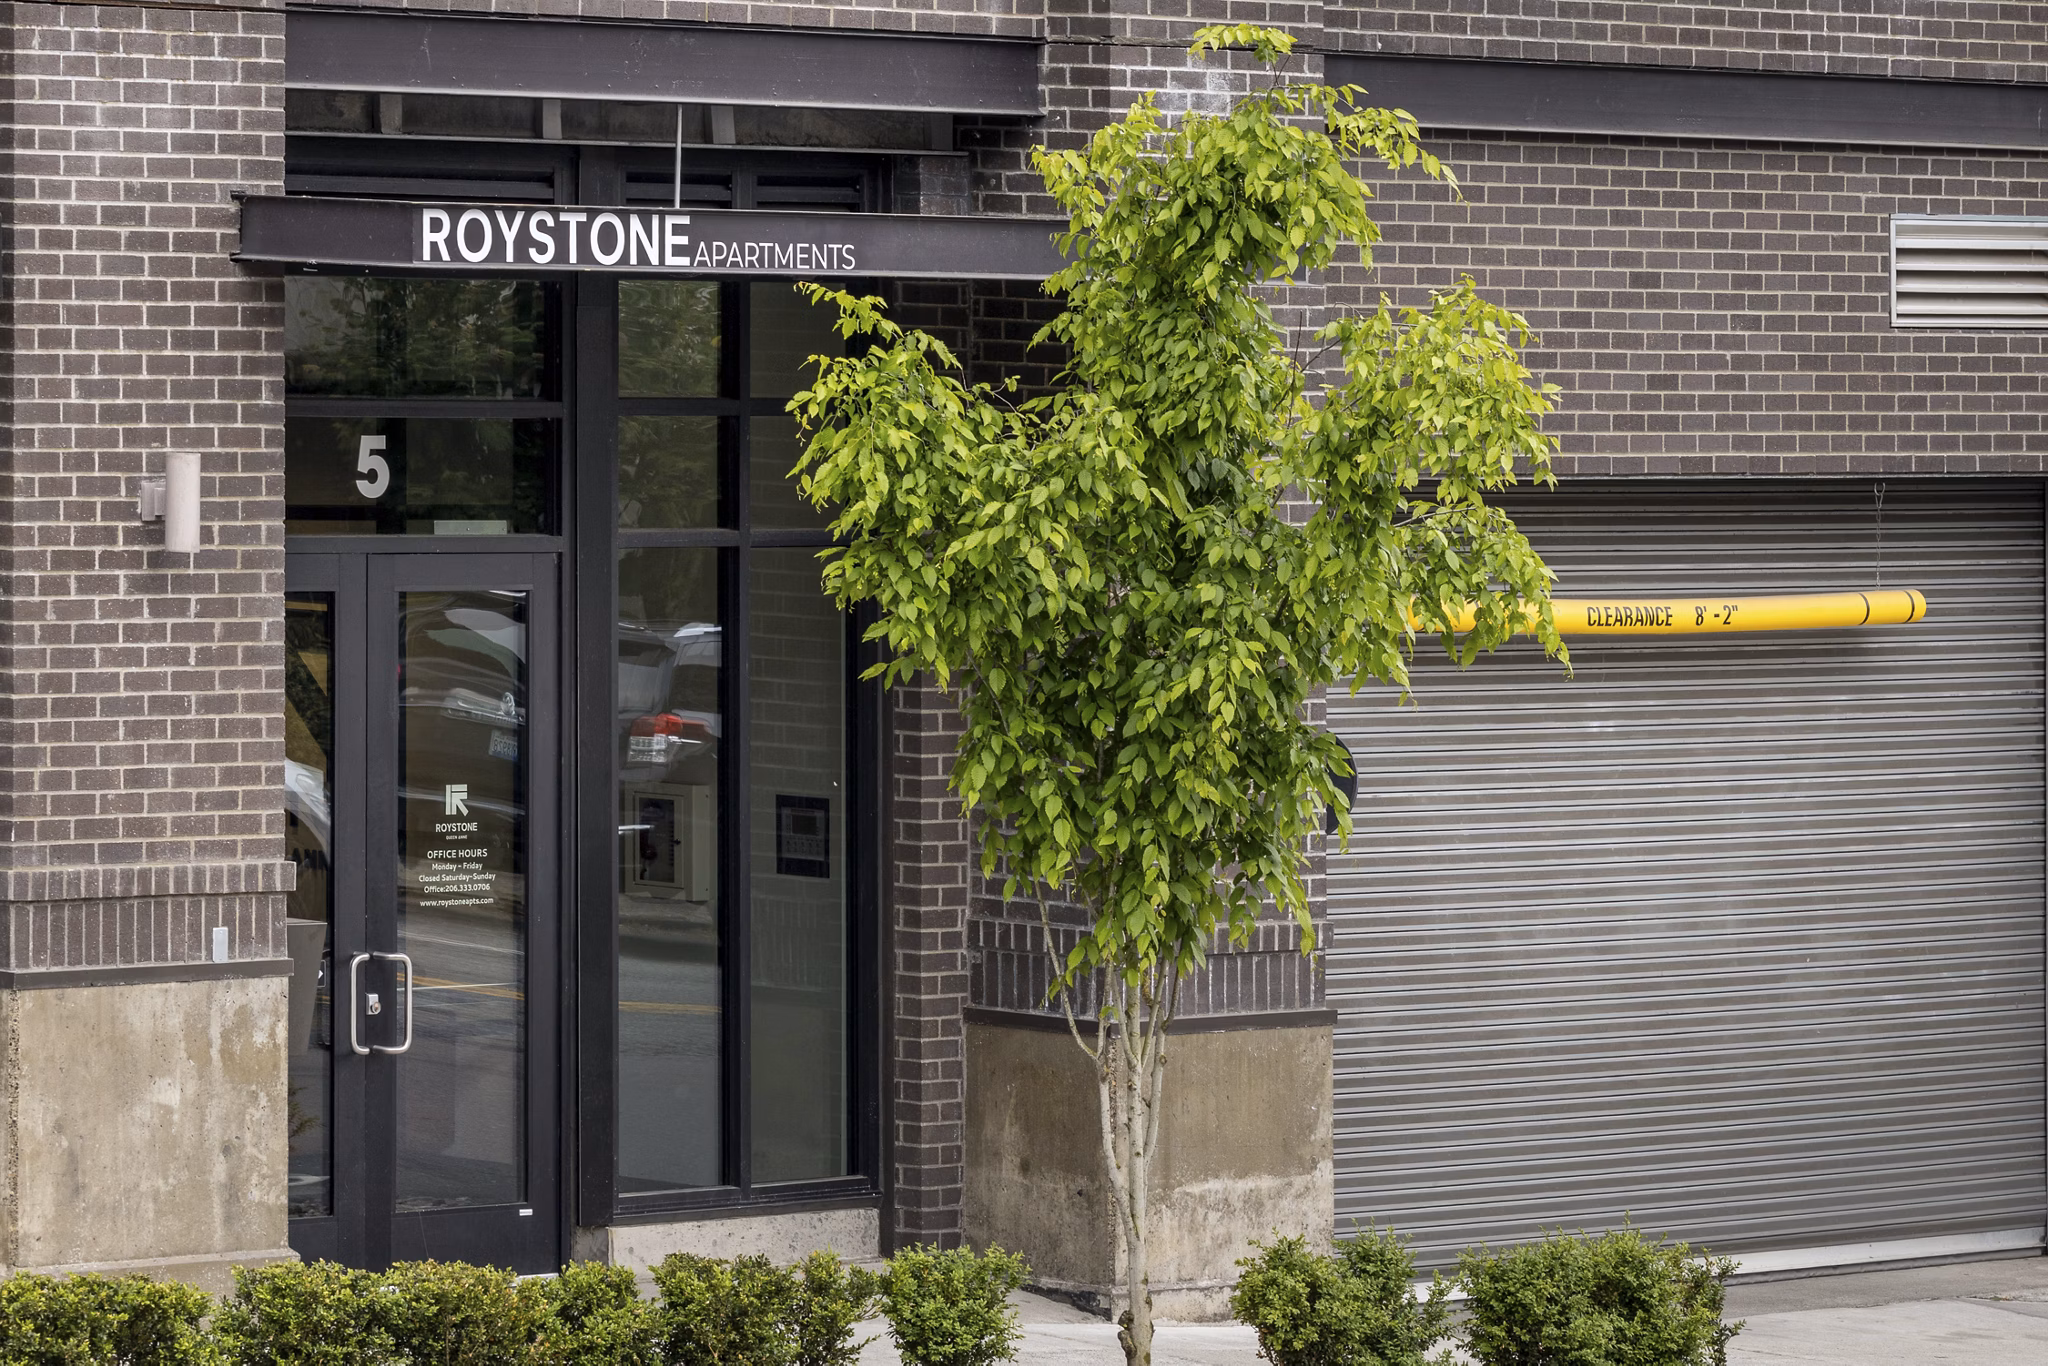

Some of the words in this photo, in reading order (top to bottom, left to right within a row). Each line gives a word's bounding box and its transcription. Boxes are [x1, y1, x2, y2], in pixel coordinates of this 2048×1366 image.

[422, 208, 691, 267] ROYSTONE
[693, 241, 856, 271] APARTMENTS
[355, 434, 390, 499] 5
[1586, 606, 1673, 627] CLEARANCE
[435, 822, 478, 833] ROYSTONE
[427, 849, 457, 859] OFFICE
[458, 848, 488, 858] HOURS
[431, 863, 457, 872] Monday
[462, 862, 483, 871] Friday
[418, 874, 440, 883] Closed
[423, 883, 491, 893] Office:206.333.0706
[419, 897, 494, 907] www.roystoneapts.com
